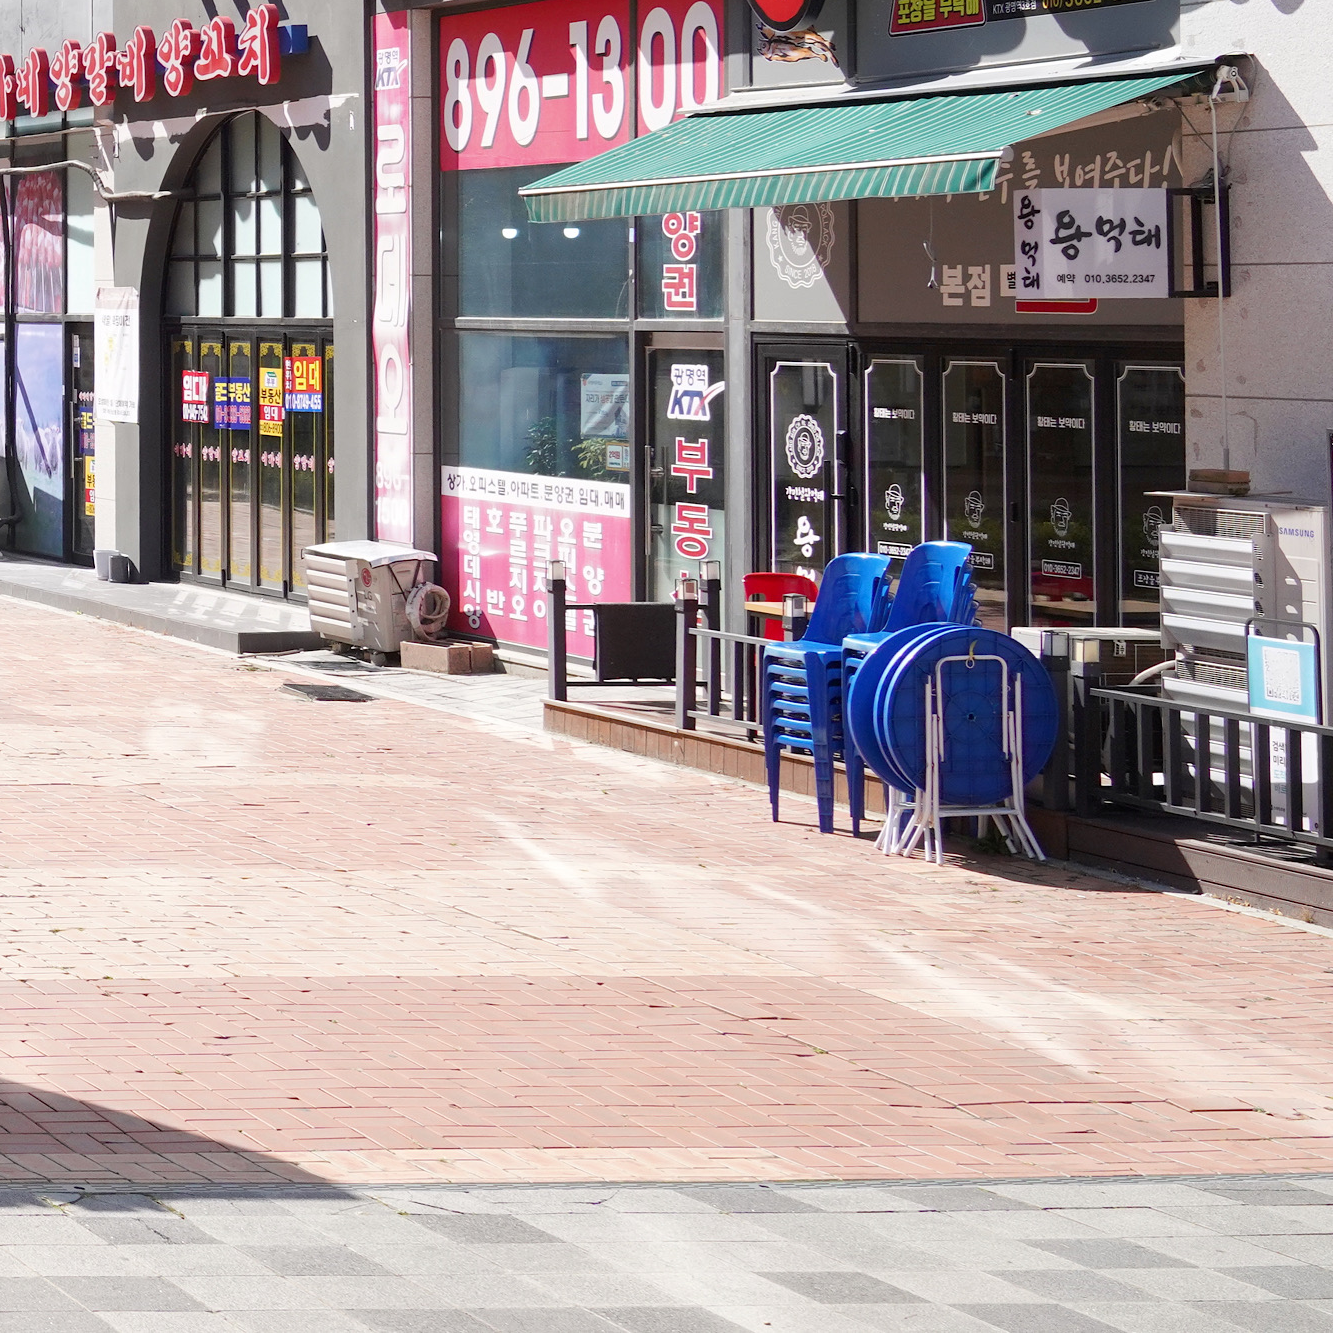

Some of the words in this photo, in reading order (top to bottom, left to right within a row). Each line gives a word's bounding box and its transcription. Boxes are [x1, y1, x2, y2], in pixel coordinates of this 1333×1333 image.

[992, 4, 1004, 16] KTX
[49, 25, 156, 110] 양갈비
[157, 4, 280, 97] 양꼬치
[375, 66, 401, 90] KTX
[443, 0, 719, 152] 896-1300
[1055, 145, 1174, 186] 보여주다!
[1017, 195, 1041, 291] 왕먹태
[1050, 209, 1161, 260] 왕먹태
[784, 265, 802, 279] SINCE
[1056, 272, 1076, 285] 예약
[1084, 273, 1155, 285] 010.3652.2347
[940, 264, 990, 307] 본점
[294, 360, 320, 391] 임대
[673, 367, 706, 386] 광명역
[183, 375, 208, 401] 임대
[229, 382, 251, 402] 부동산
[261, 389, 281, 404] 부동산
[264, 407, 278, 420] 임대
[670, 388, 709, 417] KTX
[874, 407, 891, 419] 황태는
[892, 408, 915, 420] 보약이다
[952, 412, 971, 423] 황태는
[972, 413, 997, 425] 보약이다
[1037, 416, 1057, 428] 황태는
[1058, 417, 1085, 429] 보약이다
[1129, 420, 1150, 433] 황태는
[1152, 421, 1180, 435] 보약이다
[1278, 528, 1314, 538] SAMSUNG
[463, 506, 480, 629] 태영데시앙
[487, 508, 505, 616] 호반
[509, 513, 527, 621] 푸르지오
[1043, 562, 1080, 577] 010-3652-2347
